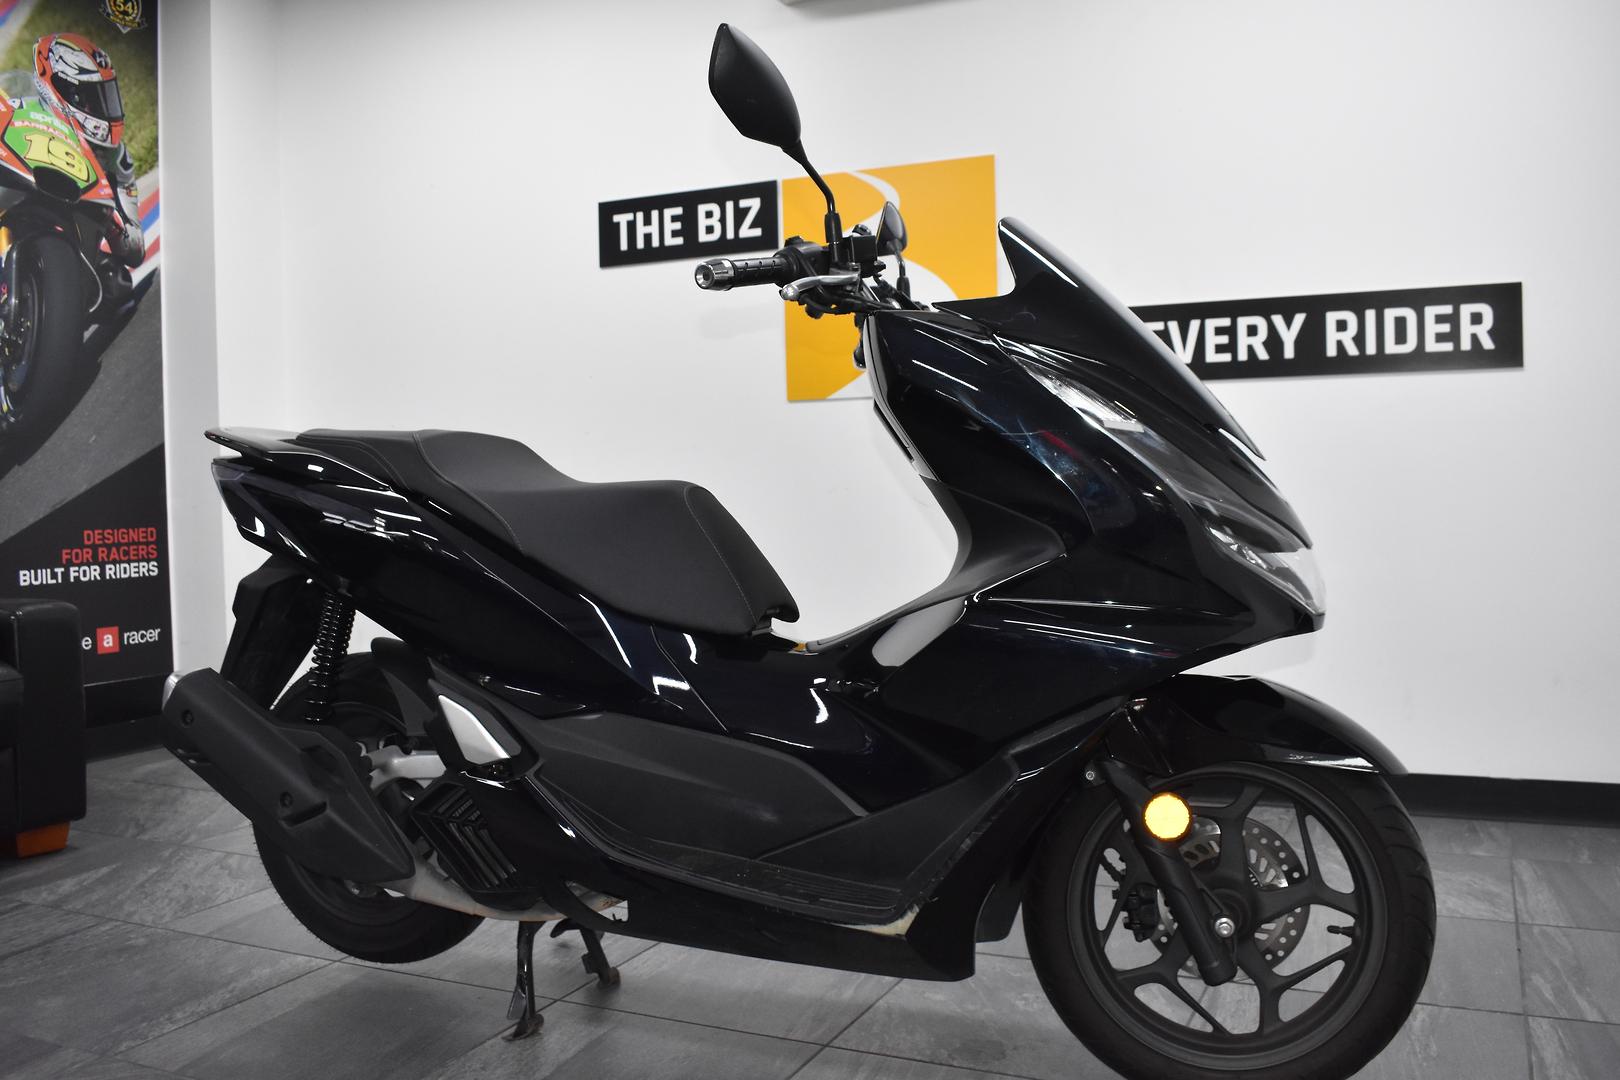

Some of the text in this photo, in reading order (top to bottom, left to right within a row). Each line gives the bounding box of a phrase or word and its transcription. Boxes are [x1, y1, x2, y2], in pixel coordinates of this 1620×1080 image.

[612, 196, 764, 252] THE BIZ
[1325, 302, 1497, 359] RIDER
[84, 528, 157, 544] DESIGNED
[62, 545, 158, 564] FOR RACERS
[19, 561, 159, 586] BUILT FOR RIDERS
[103, 634, 113, 647] a
[124, 628, 160, 644] racer
